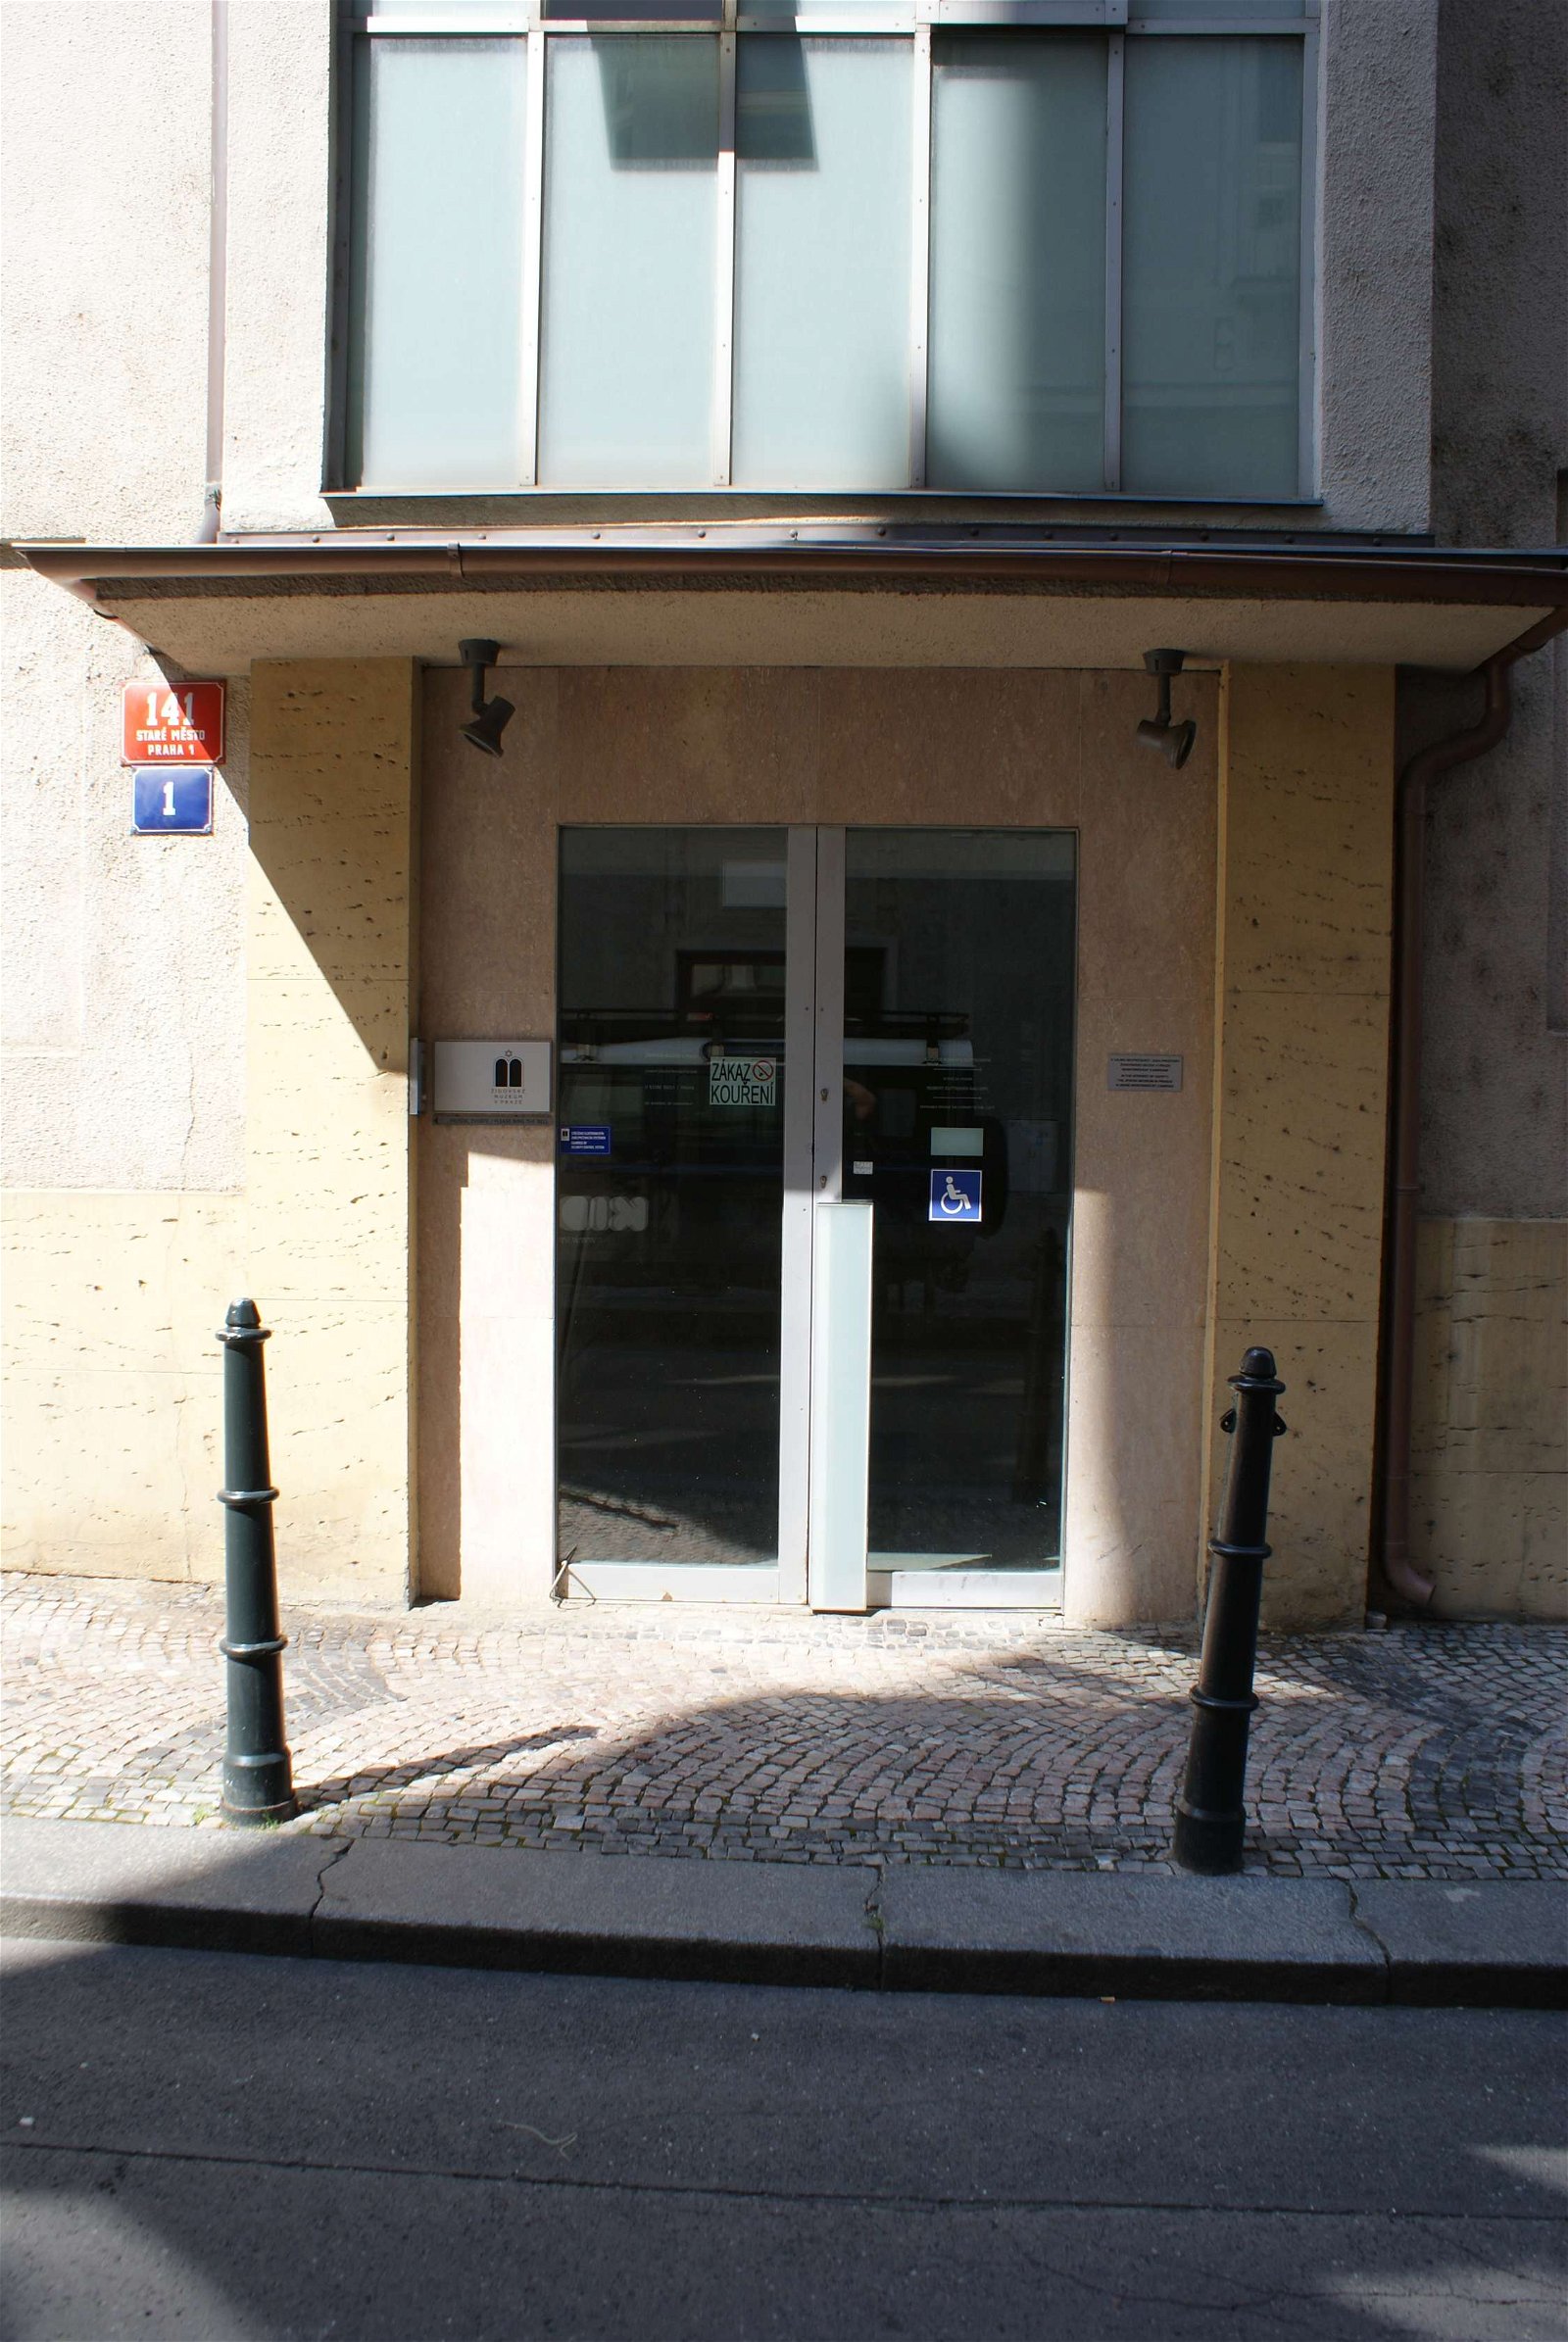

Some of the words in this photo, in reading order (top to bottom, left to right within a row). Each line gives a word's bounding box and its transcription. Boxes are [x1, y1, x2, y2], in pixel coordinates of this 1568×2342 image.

[146, 692, 194, 726] 141
[136, 727, 167, 741] STARÉ
[171, 726, 205, 741] MĚSTO
[148, 744, 184, 756] PRAHA
[188, 744, 195, 756] 1
[163, 781, 176, 816] 1
[711, 1059, 751, 1082] ZÁKAZ
[710, 1081, 773, 1104] KOUŘENÍ
